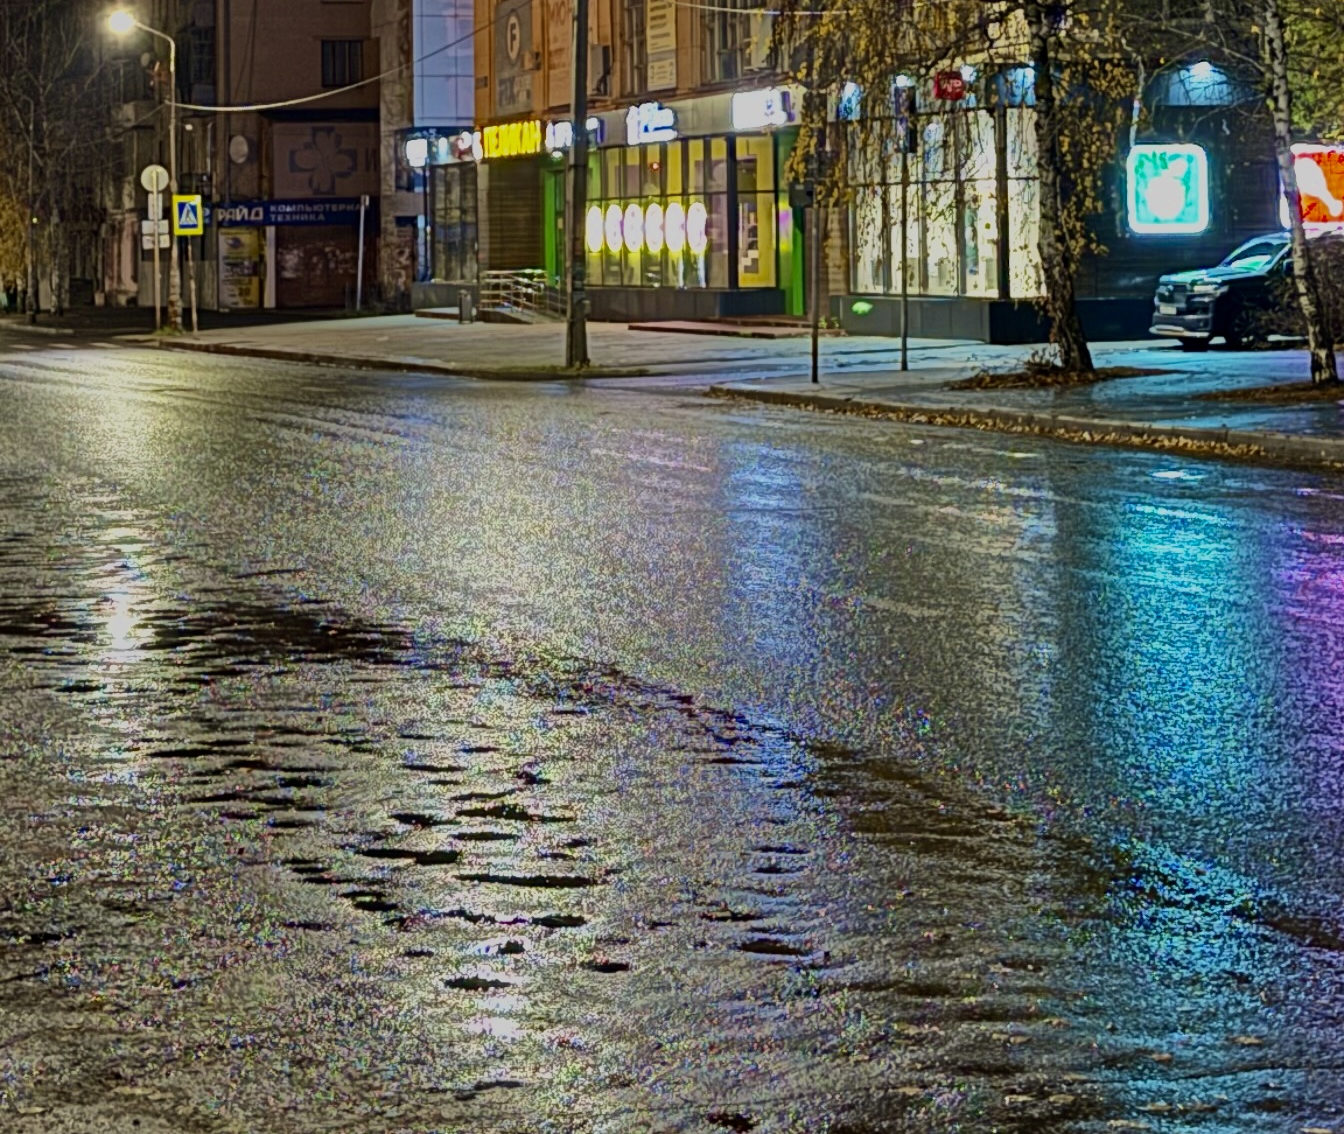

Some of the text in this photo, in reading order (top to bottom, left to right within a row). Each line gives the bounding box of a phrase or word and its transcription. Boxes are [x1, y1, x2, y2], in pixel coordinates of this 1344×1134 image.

[483, 119, 542, 159] ПЕЛИКАН
[269, 202, 369, 213] КОМПЬЮТЕРНА
[269, 212, 326, 222] ТЕХНИКА
